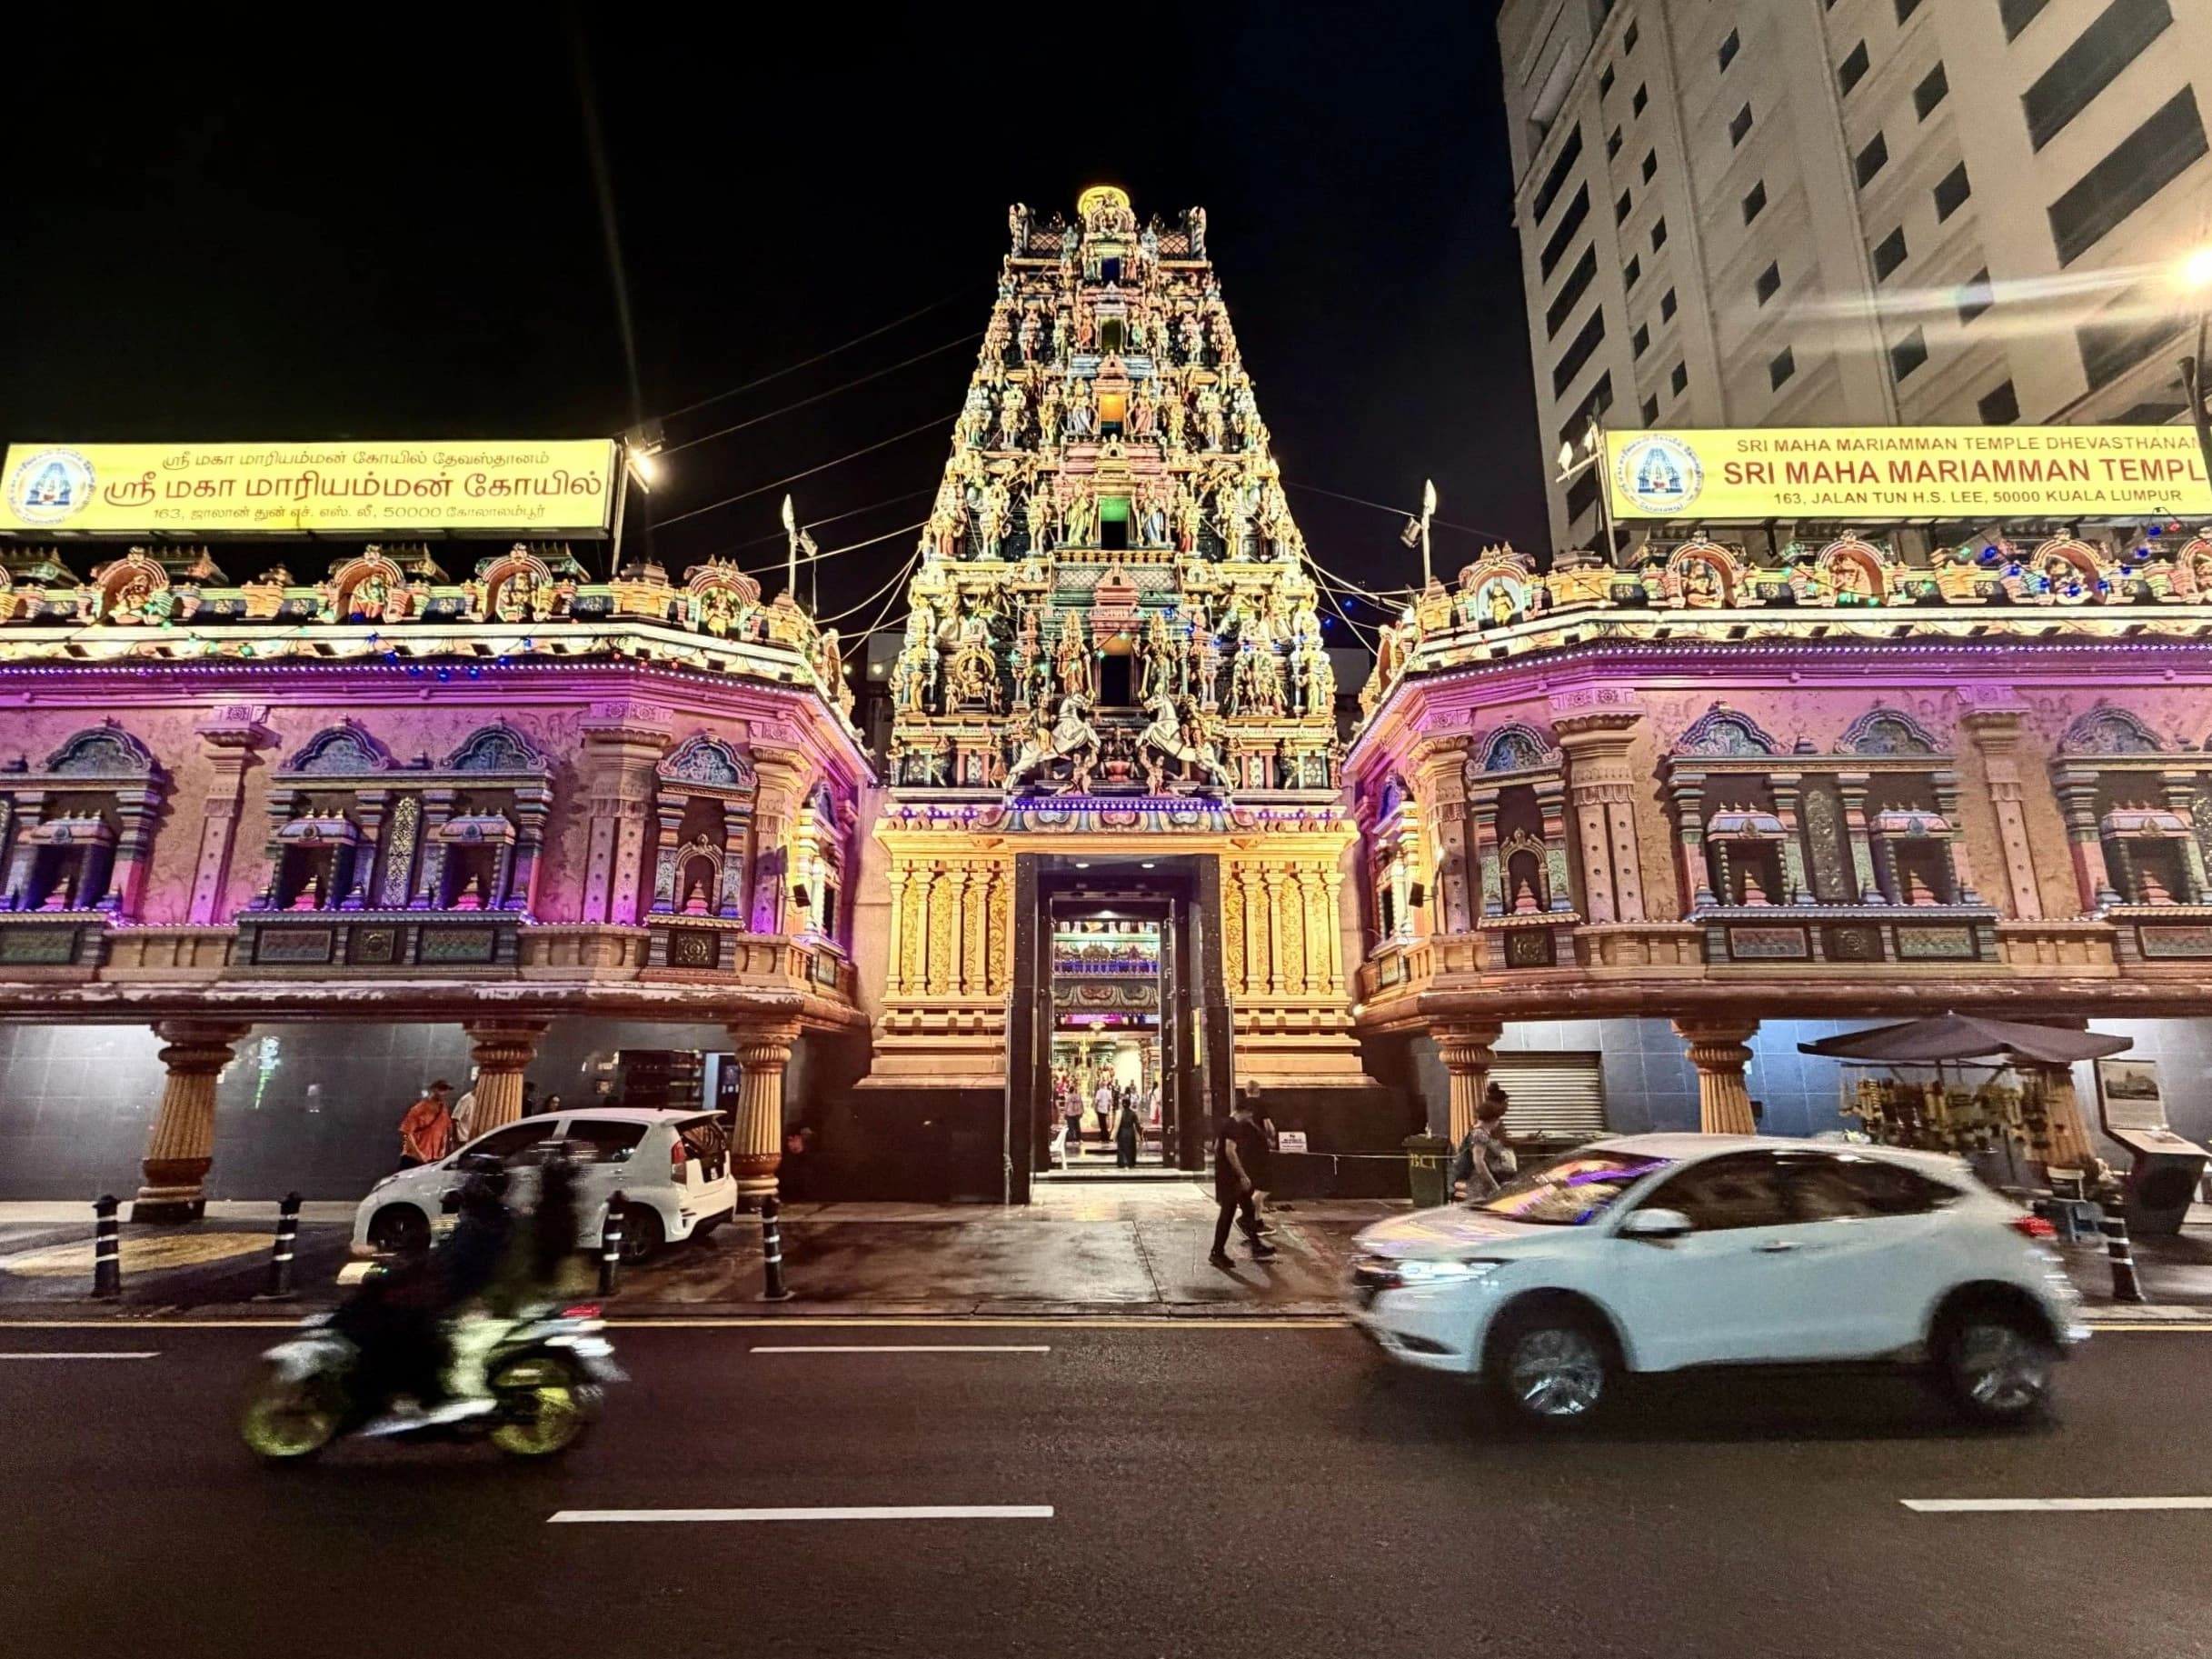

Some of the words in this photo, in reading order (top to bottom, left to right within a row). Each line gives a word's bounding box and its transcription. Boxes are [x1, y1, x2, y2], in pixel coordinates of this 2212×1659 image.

[1737, 439, 1769, 453] SRI
[1774, 438, 1831, 452] MAHA
[1836, 437, 1958, 451] MARIAMMAN
[1964, 436, 2040, 450] TEMPLE
[195, 455, 234, 465] மகா
[240, 451, 347, 466] மாரியம்மன்
[353, 450, 427, 465] கோயில்
[433, 452, 549, 469] தேவஸ்தானம்
[1724, 461, 1775, 485] SRI
[1785, 460, 1880, 485] MAHA
[1888, 459, 2090, 483] MARIAMMAN
[104, 471, 156, 507] ஸ்ரீ
[165, 479, 236, 498] மகா
[245, 470, 454, 501] மாரியம்மன்
[464, 470, 602, 497] கோயில்
[1774, 493, 1807, 505] 163,
[1811, 492, 1868, 504] JALAN
[1872, 492, 1908, 504] TUN
[1913, 491, 1946, 504] H.S.
[1951, 491, 1988, 505] LEE,
[1993, 491, 2040, 503] 50000
[2047, 490, 2106, 502] KUALA
[2111, 489, 2182, 501] LUMPUR
[154, 508, 185, 521] 163,
[191, 505, 250, 521] ஜாலான்
[254, 505, 284, 522] துன்
[319, 505, 352, 517] எஸ்.
[384, 506, 442, 518] 50000
[446, 505, 545, 520] கோலாலம்பூர்
